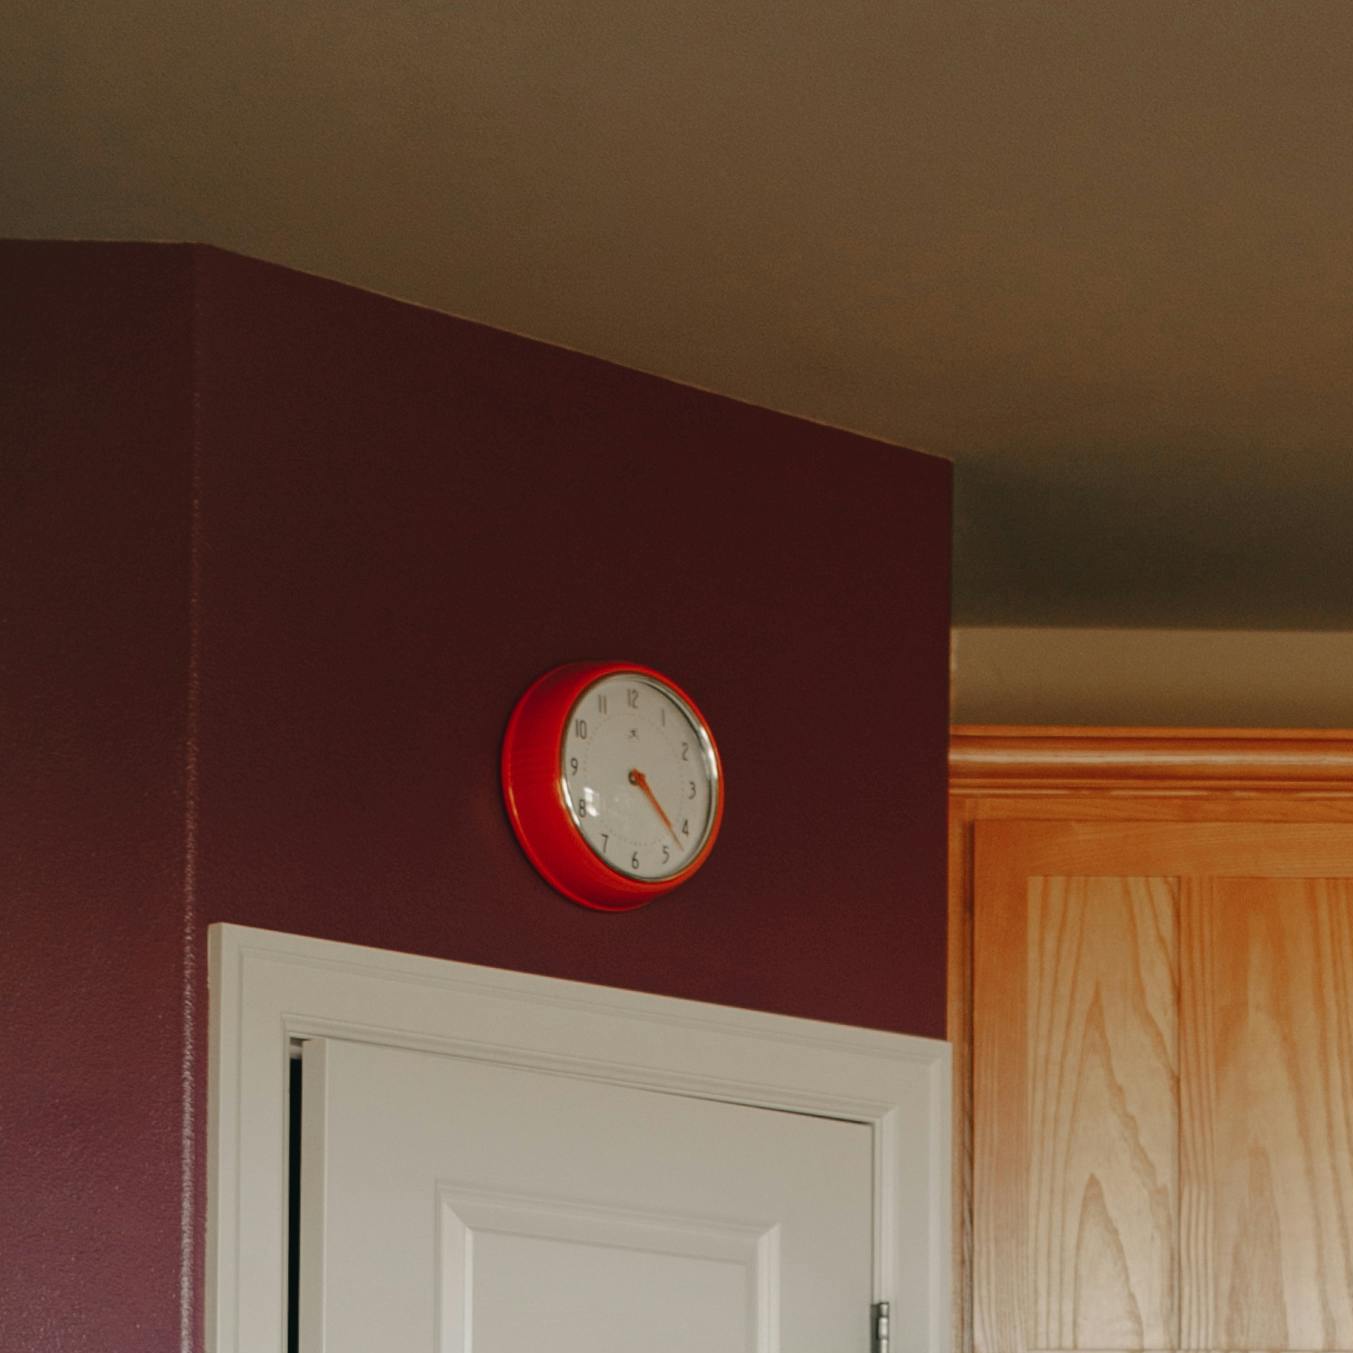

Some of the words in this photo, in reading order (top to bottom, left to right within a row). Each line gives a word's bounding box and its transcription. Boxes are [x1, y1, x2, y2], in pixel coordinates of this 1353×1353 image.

[598, 694, 608, 714] 11
[627, 688, 639, 709] 12
[660, 709, 666, 727] 1
[575, 719, 587, 739] 10
[681, 742, 689, 761] 2
[570, 757, 578, 776] 9
[688, 781, 696, 799] 3
[578, 798, 586, 818] 8
[681, 818, 689, 836] 4
[601, 833, 609, 853] 7
[631, 852, 639, 870] 6
[662, 845, 670, 865] 5
